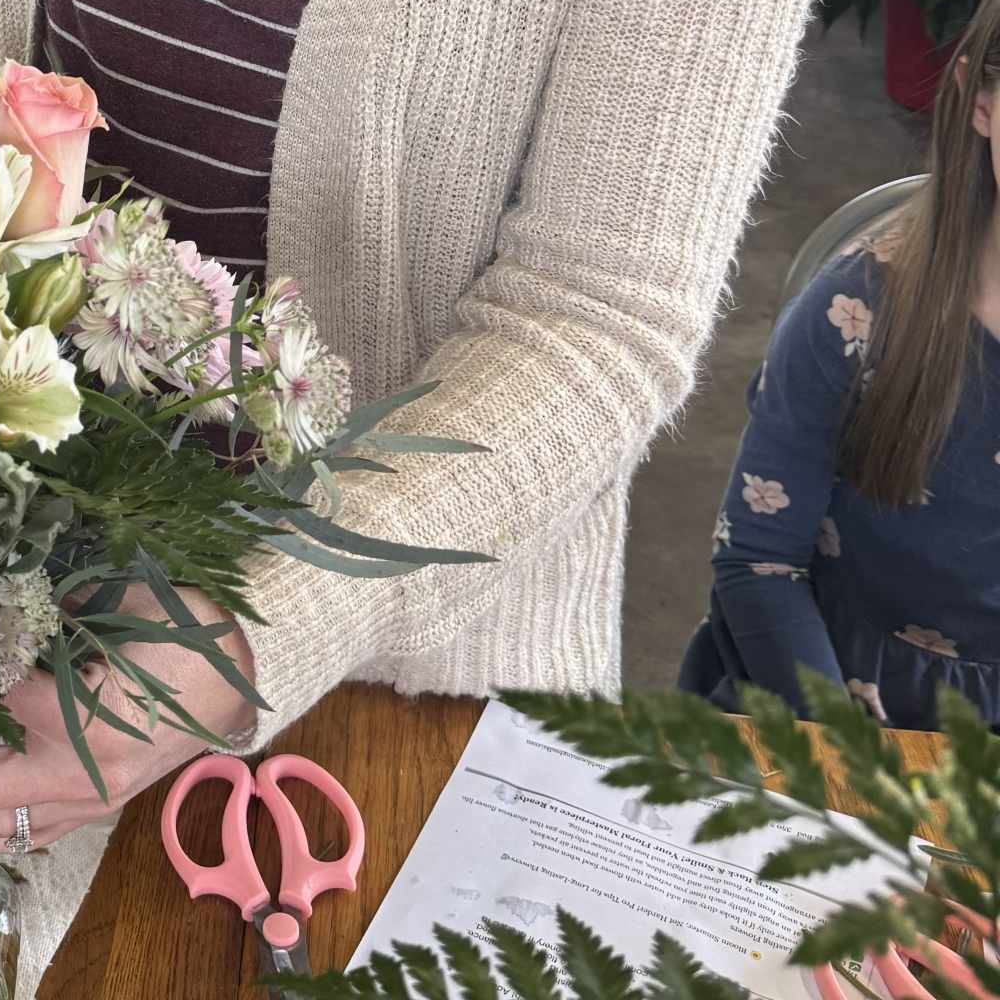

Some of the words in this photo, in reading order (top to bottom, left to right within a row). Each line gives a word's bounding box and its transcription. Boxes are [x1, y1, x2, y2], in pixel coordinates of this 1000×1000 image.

[512, 792, 547, 809] Ready!
[528, 818, 544, 828] that
[543, 823, 558, 833] gas
[558, 807, 620, 836] Masterpiece
[593, 832, 623, 847] prevent
[619, 831, 651, 849] Floral
[560, 850, 581, 863] when
[569, 843, 599, 858] prevent
[616, 850, 634, 862] they
[632, 847, 650, 858] heat
[652, 844, 680, 860] Your
[580, 857, 600, 869] food
[608, 858, 630, 870] water
[649, 854, 666, 865] and
[679, 855, 715, 872] Smile!
[599, 864, 623, 879] flower
[630, 866, 644, 876] the
[665, 860, 699, 877] sunlight
[538, 866, 590, 892] Long-Lasting
[623, 874, 643, 885] with
[644, 872, 672, 887] refresh
[685, 877, 703, 888] and
[698, 872, 722, 883] direct
[725, 869, 753, 884] Back
[643, 881, 665, 894] water
[672, 883, 688, 893] you
[702, 882, 722, 894] fruit
[721, 878, 743, 890] from
[588, 886, 602, 897] for
[601, 891, 621, 904] Tips
[665, 891, 682, 902] add
[720, 888, 756, 907] ripening
[742, 885, 764, 899] away
[620, 898, 635, 909] Pro
[680, 897, 698, 906] and
[707, 894, 727, 907] each
[635, 905, 667, 922] Harder!
[697, 901, 718, 914] dirty
[726, 900, 758, 919] slightly
[755, 901, 777, 916] from
[764, 894, 817, 921] arrangement
[668, 917, 683, 927] Not
[717, 909, 741, 923] looks
[756, 913, 780, 927] angle
[776, 910, 799, 925] away
[683, 922, 720, 942] Smarter,
[728, 924, 762, 943] Flowers
[755, 924, 775, 937] only
[720, 938, 747, 954] Bloom
